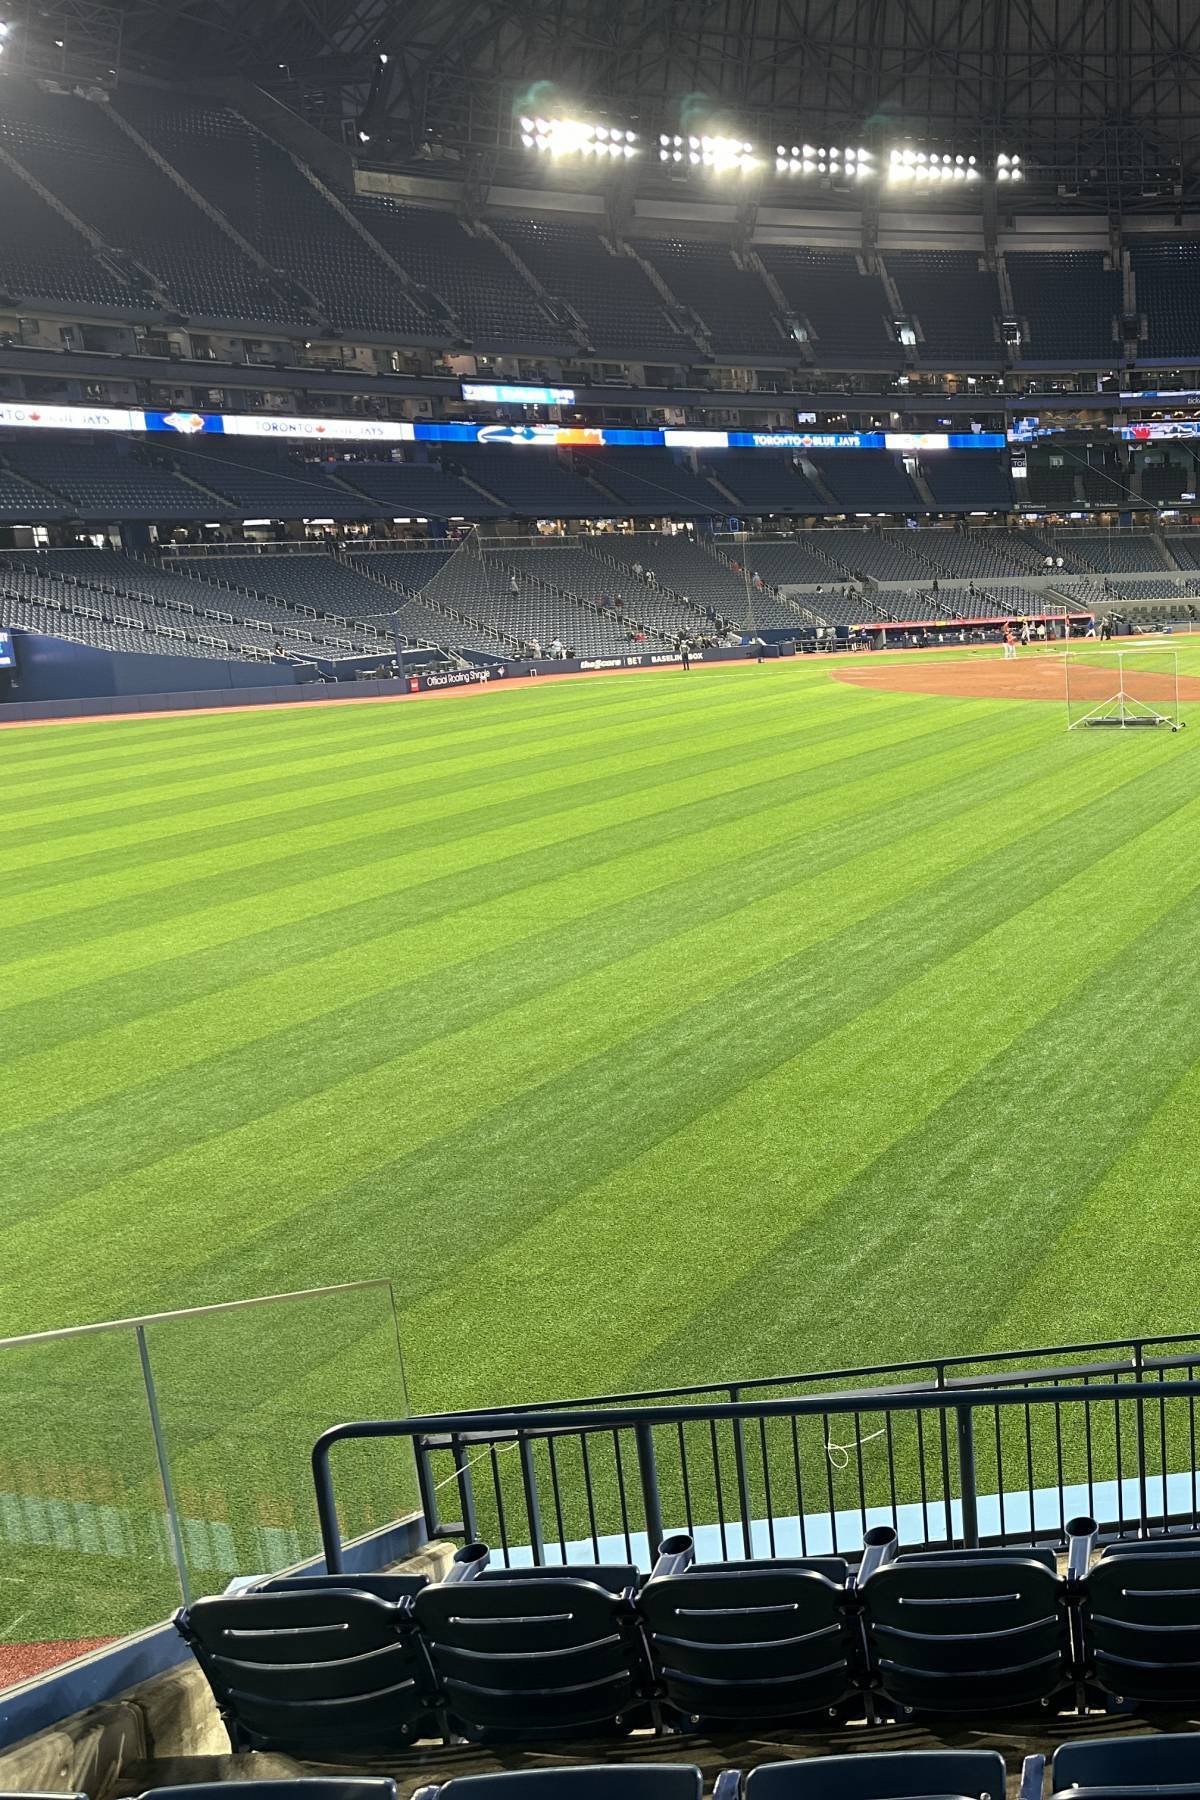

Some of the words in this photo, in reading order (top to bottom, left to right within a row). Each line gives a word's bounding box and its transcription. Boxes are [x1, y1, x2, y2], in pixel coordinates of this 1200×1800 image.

[256, 422, 313, 433] TORONTO
[753, 435, 801, 446] TORONTO
[812, 436, 835, 446] BLUE
[837, 436, 860, 446] JAYS
[580, 659, 621, 669] theScore
[627, 656, 642, 665] BET
[651, 654, 682, 663] BASELIN
[427, 675, 447, 686] Official
[448, 672, 469, 683] Roofing
